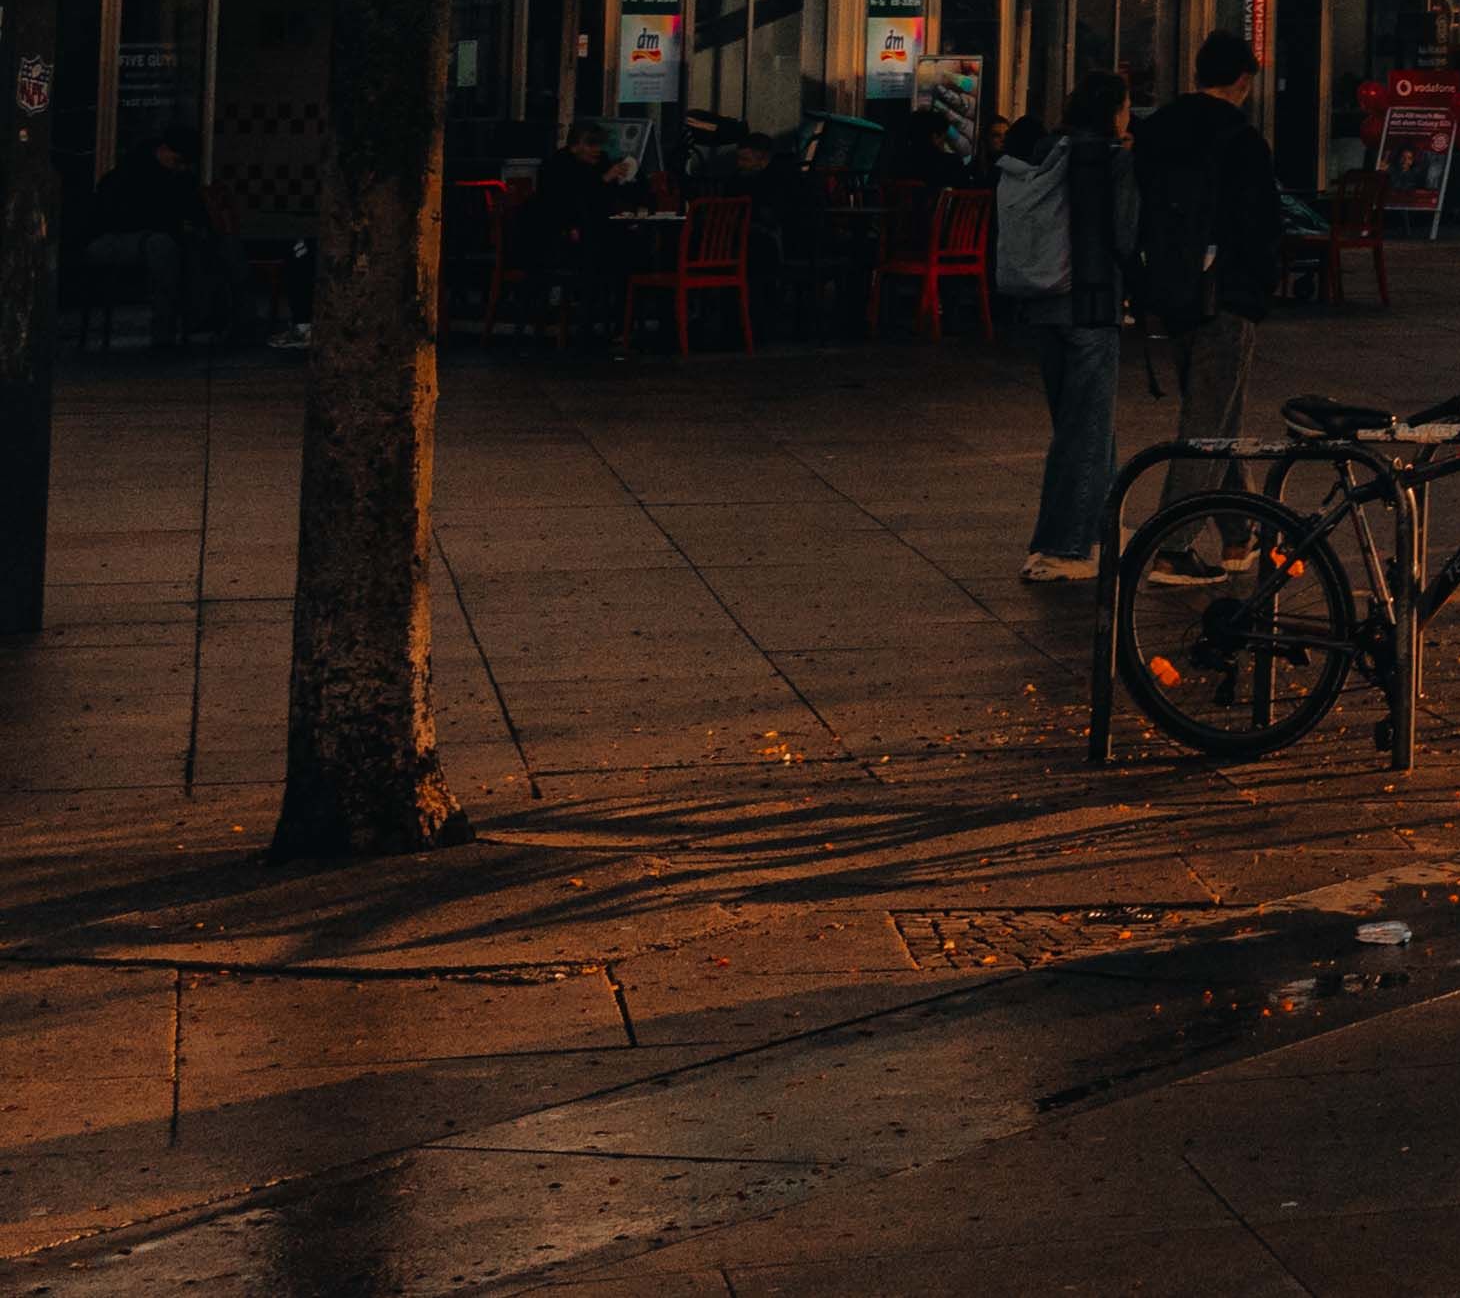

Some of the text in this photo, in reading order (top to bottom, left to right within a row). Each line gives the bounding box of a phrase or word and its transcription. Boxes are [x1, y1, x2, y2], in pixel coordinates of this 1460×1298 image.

[637, 28, 660, 49] dm
[885, 29, 905, 49] dm
[1413, 82, 1457, 94] vodafone
